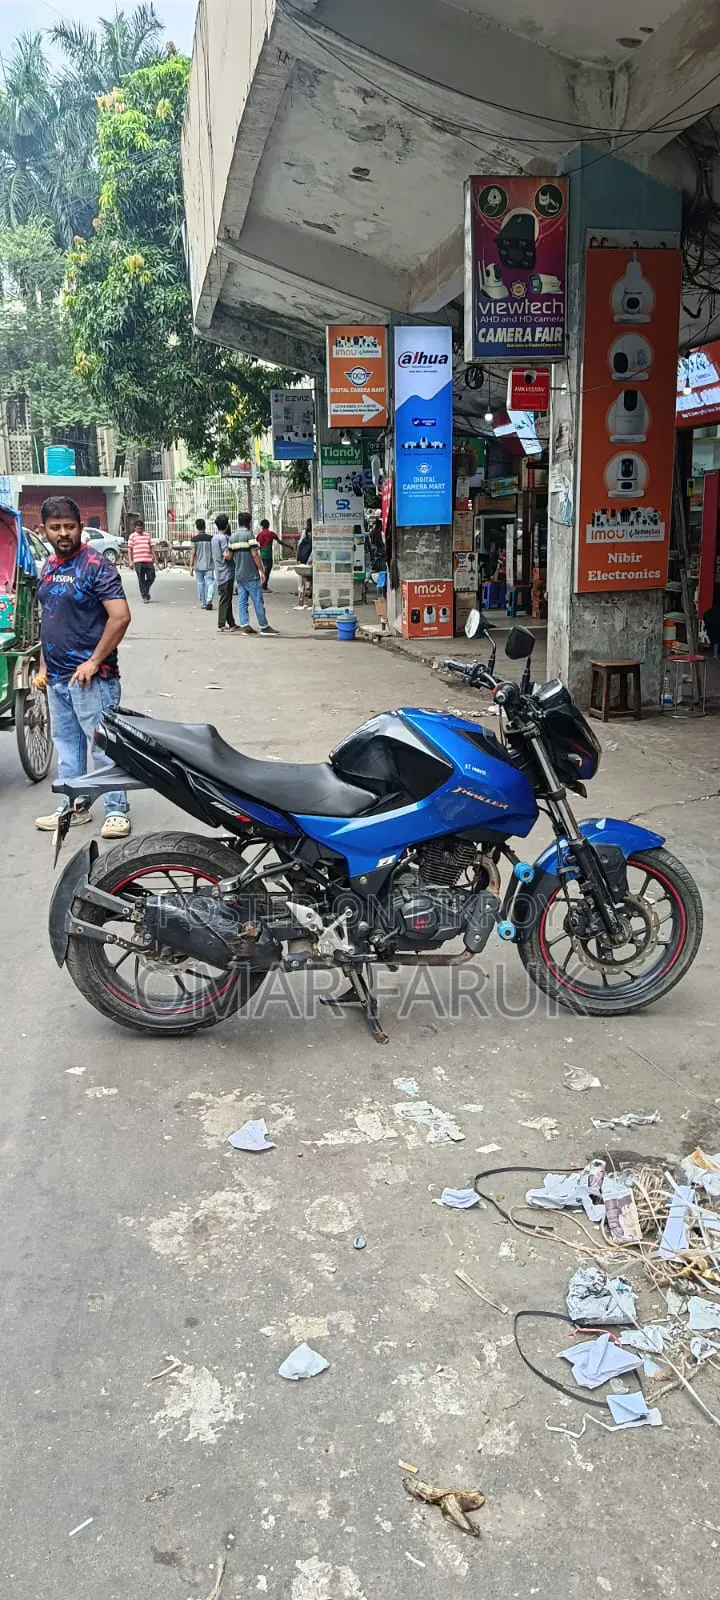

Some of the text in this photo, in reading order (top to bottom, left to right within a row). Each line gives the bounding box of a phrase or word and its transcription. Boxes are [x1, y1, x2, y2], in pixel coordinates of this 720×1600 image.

[480, 315, 500, 323] AHD
[501, 315, 517, 323] and
[519, 315, 533, 323] HD
[478, 327, 563, 342] CAMERA FAIR
[322, 446, 360, 459] Tiandy
[607, 552, 643, 564] Nibir
[587, 568, 661, 581] Electronics
